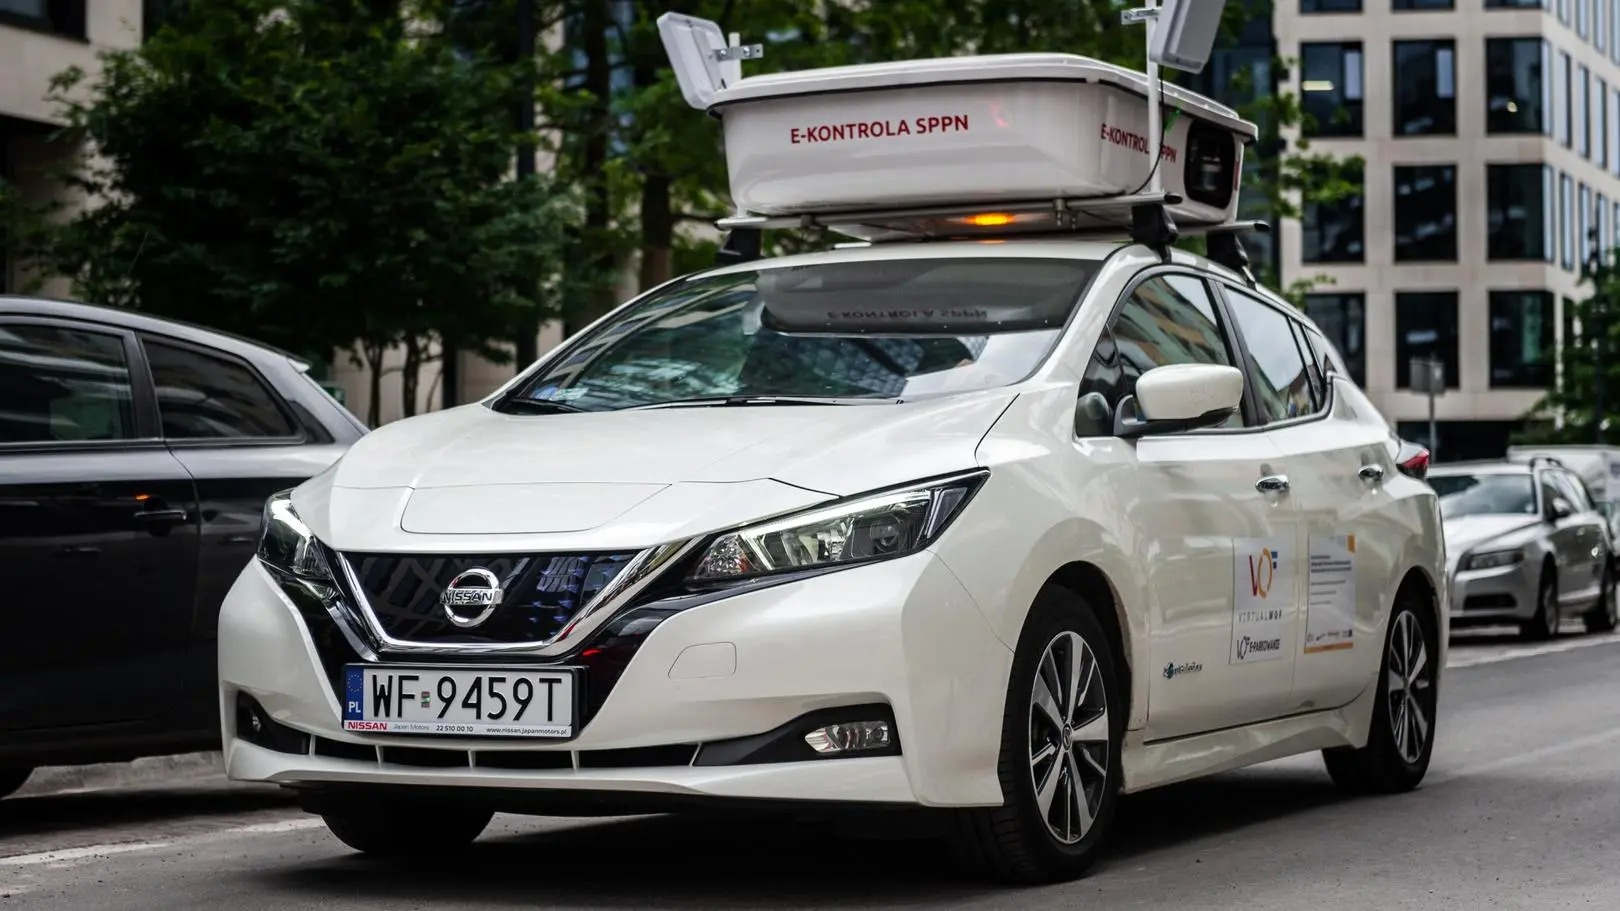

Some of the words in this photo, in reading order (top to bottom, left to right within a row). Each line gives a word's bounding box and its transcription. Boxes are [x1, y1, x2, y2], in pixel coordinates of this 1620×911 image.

[790, 119, 911, 144] E-KONTROLA
[915, 115, 969, 134] SPPN
[1101, 123, 1150, 155] E-KONTROL
[443, 590, 493, 602] NISSAN
[348, 701, 362, 713] PL
[372, 674, 420, 718] WF
[436, 675, 563, 722] 9459T
[348, 721, 388, 730] NISSAN
